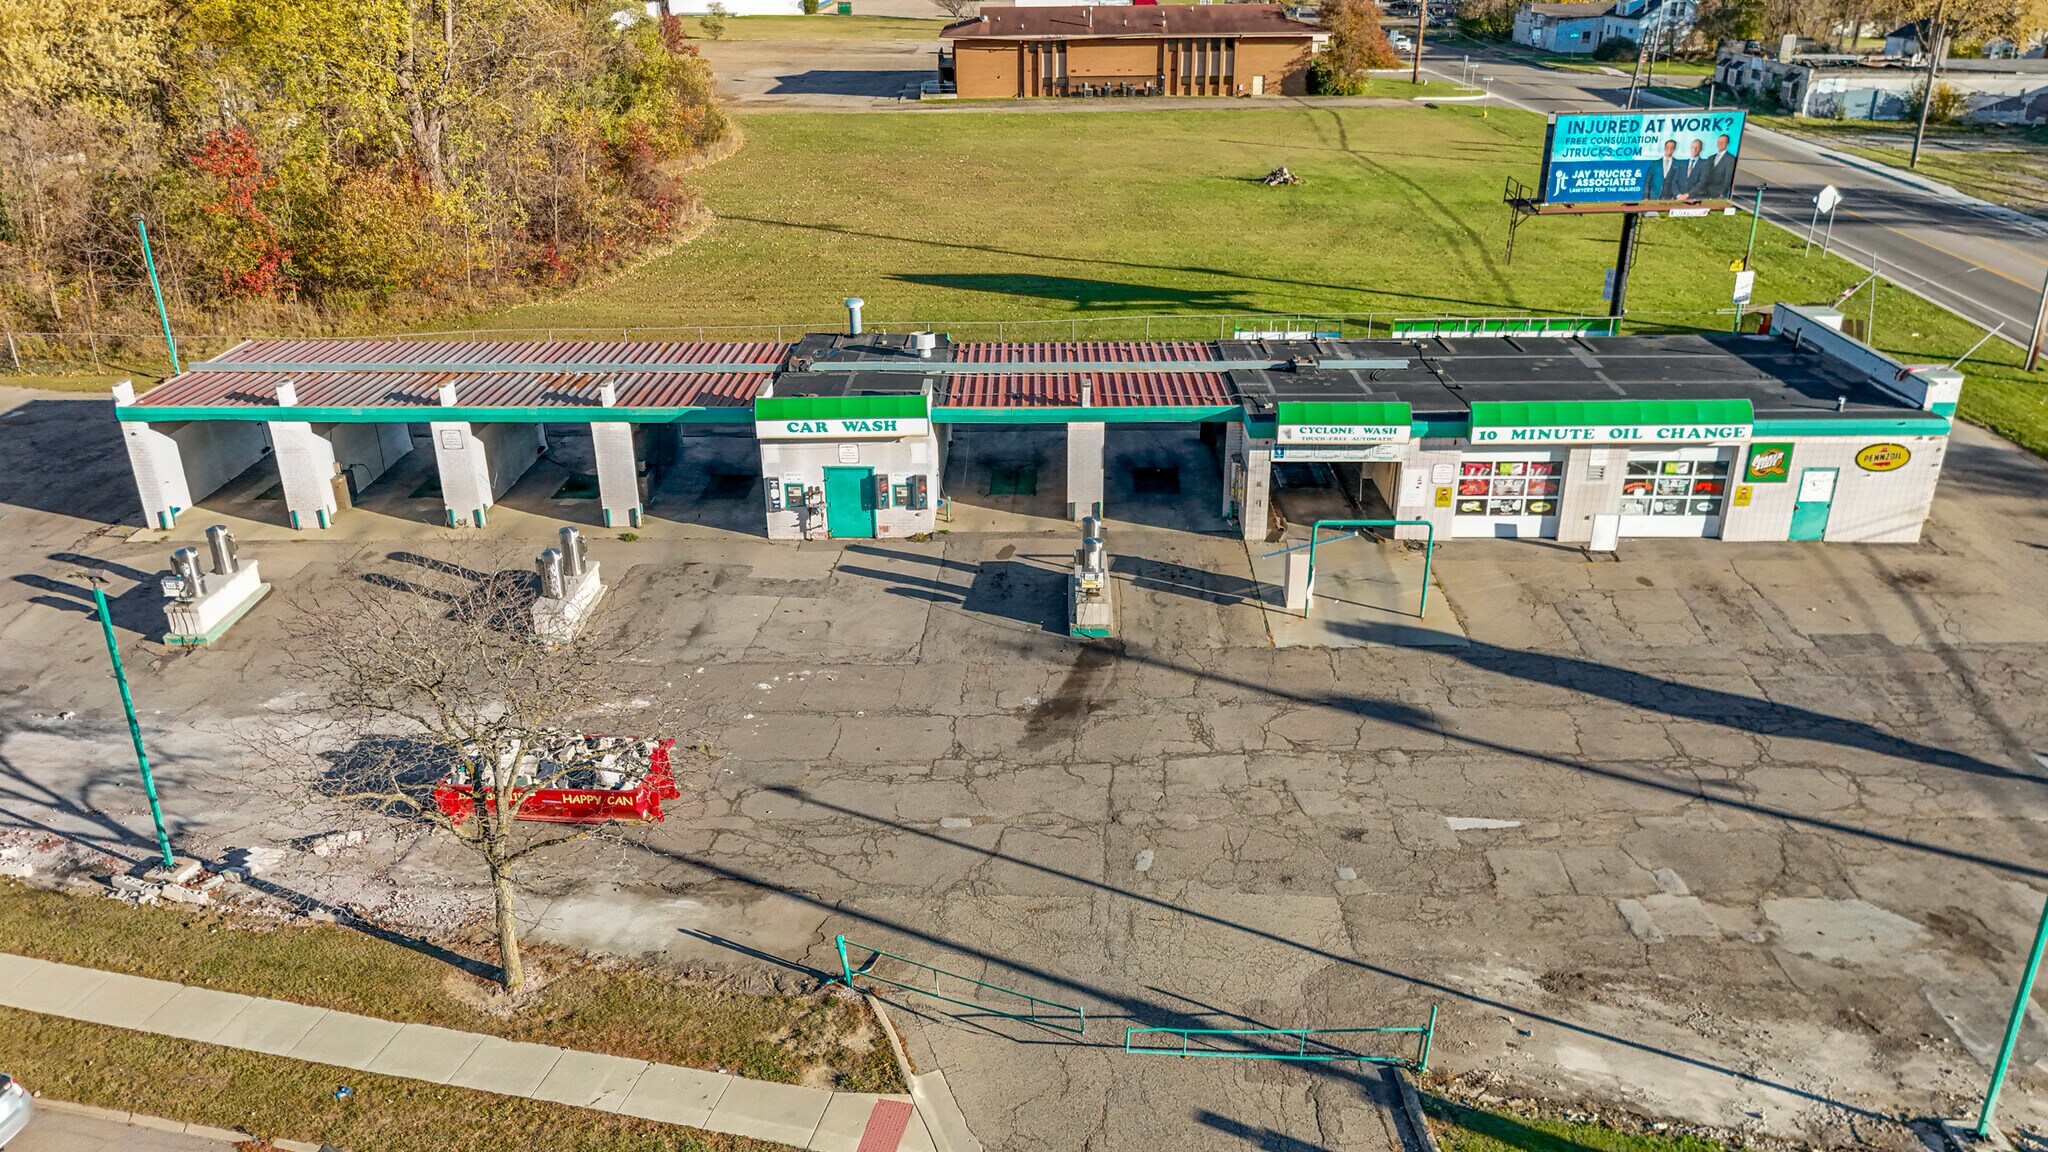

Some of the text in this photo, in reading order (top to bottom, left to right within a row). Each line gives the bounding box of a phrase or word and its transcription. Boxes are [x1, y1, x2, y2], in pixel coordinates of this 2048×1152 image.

[1567, 117, 1734, 134] INJURED AT WORK?
[1565, 136, 1659, 145] FREE CONSULTATION
[1562, 147, 1642, 158] JTRUCKS.COM
[1572, 168, 1643, 179] JAY TRUCKS &
[1575, 178, 1637, 187] ASSOCIATES
[786, 420, 897, 433] CAR WASH
[1299, 426, 1398, 435] CYCLONE WASH
[1478, 426, 1746, 441] 10 MINUTE OIL CHANGE
[1864, 452, 1902, 462] PENNZOIL
[562, 793, 634, 806] HAPPY CAN
